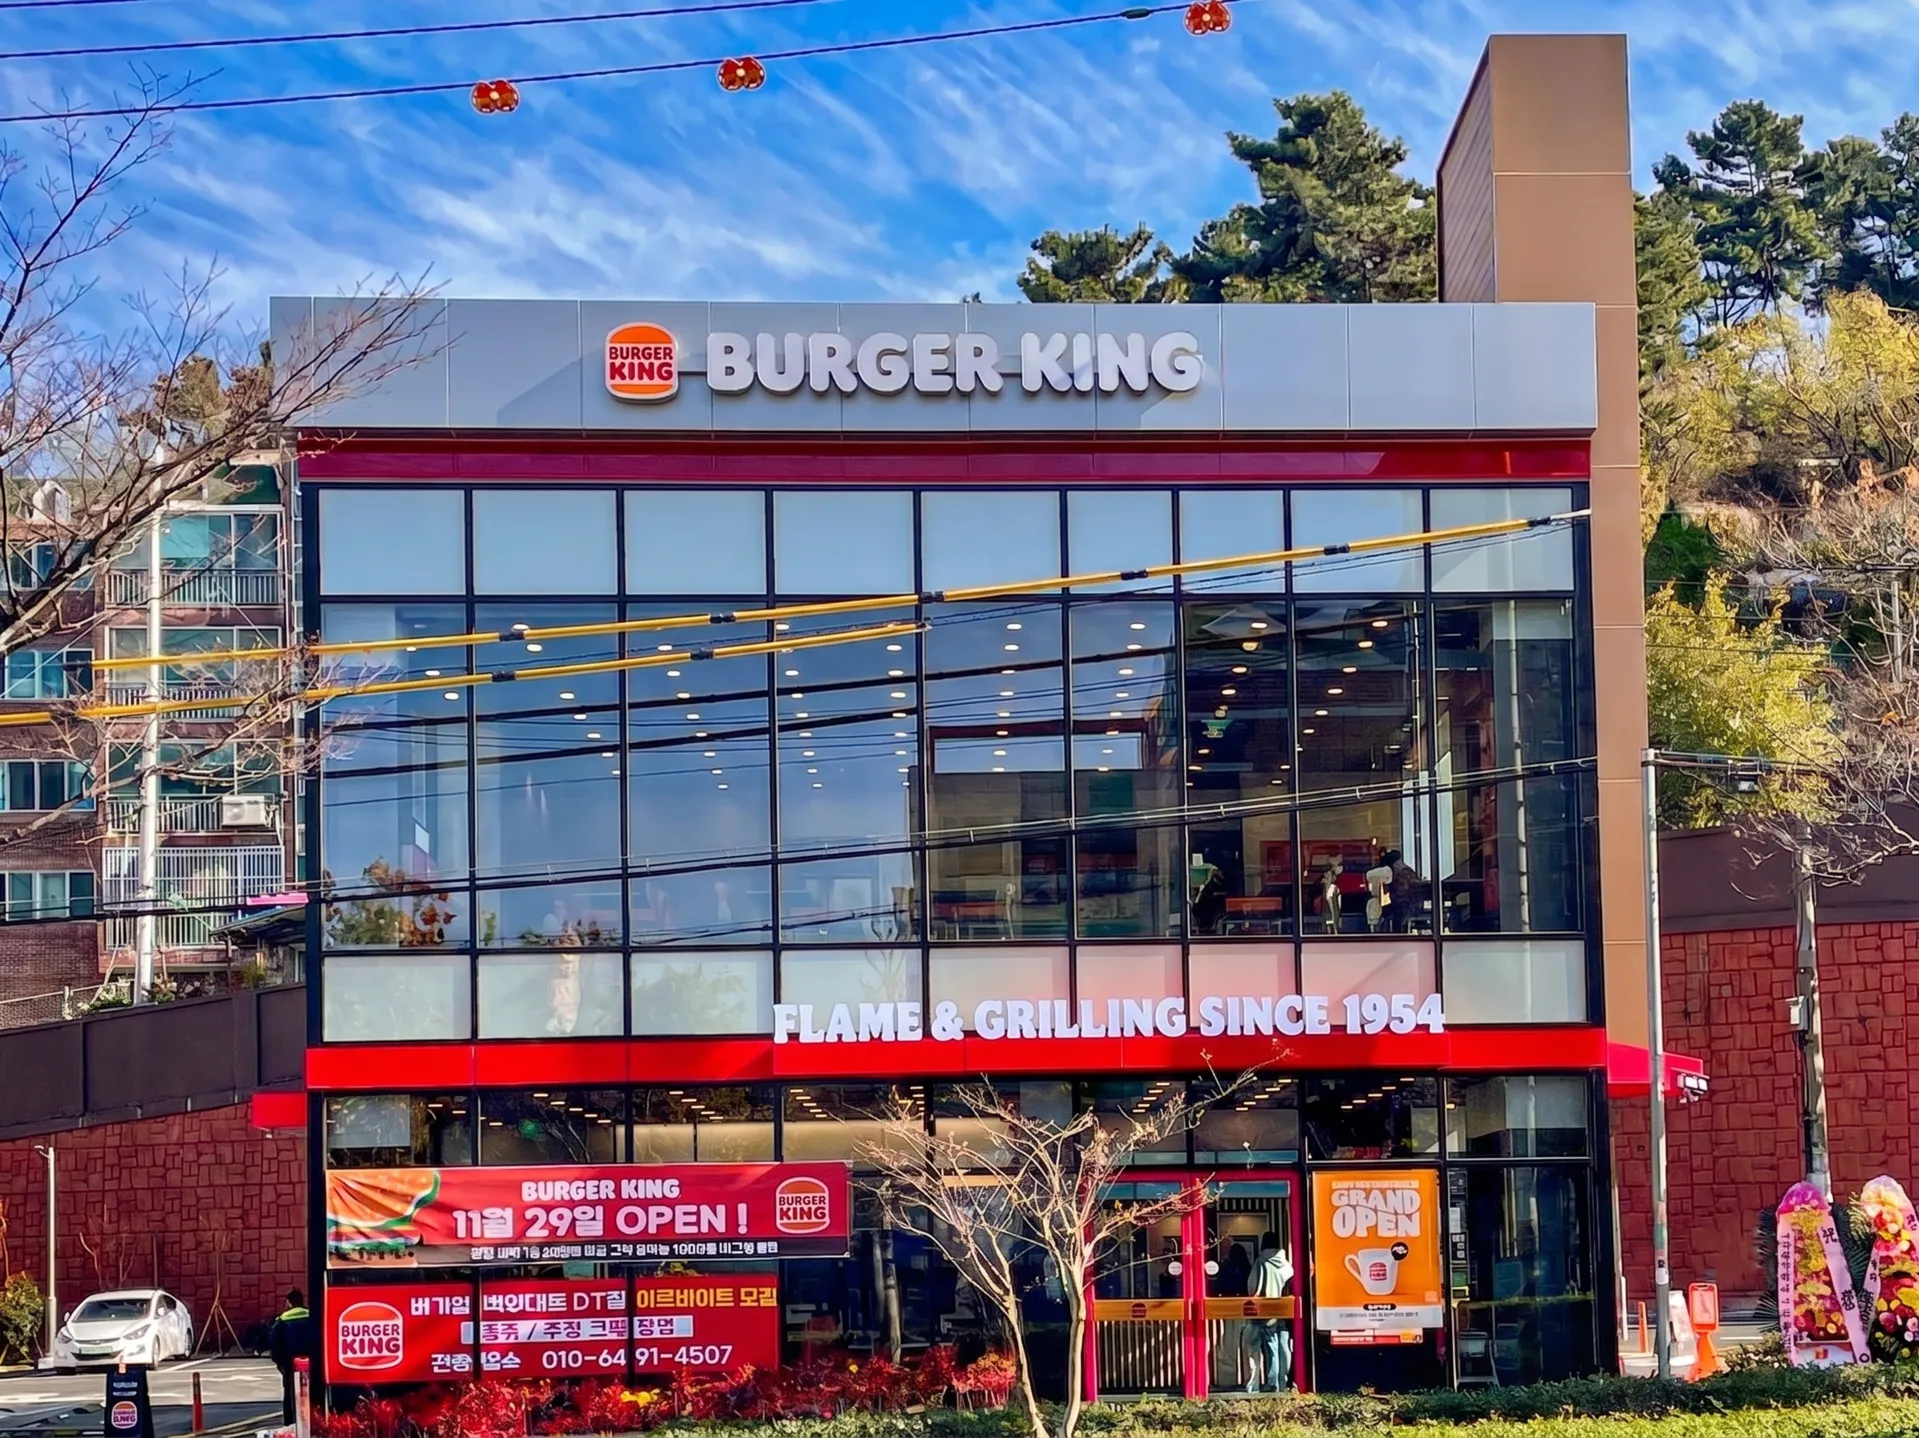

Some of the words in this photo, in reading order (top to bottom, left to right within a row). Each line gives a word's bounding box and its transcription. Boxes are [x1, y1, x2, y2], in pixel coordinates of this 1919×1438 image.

[608, 346, 673, 360] BURGER
[707, 332, 1003, 394] BURGER
[1021, 331, 1202, 394] KING
[609, 361, 673, 381] KING
[773, 1002, 922, 1043] FLAME
[931, 1000, 964, 1040] &
[974, 997, 1186, 1040] GRILLING
[1200, 995, 1330, 1037] SINCE
[1344, 994, 1446, 1035] 1954
[521, 1179, 616, 1201] BURGER
[621, 1178, 681, 1200] KING
[778, 1195, 827, 1206] BURGER
[1331, 1189, 1421, 1215] GRAND
[452, 1207, 514, 1239] 11월
[524, 1205, 604, 1237] 29일
[616, 1204, 727, 1235] OPEN
[778, 1206, 827, 1221] KING
[1332, 1206, 1421, 1238] OPEN
[341, 1323, 401, 1337] BURGER
[341, 1338, 401, 1356] KING
